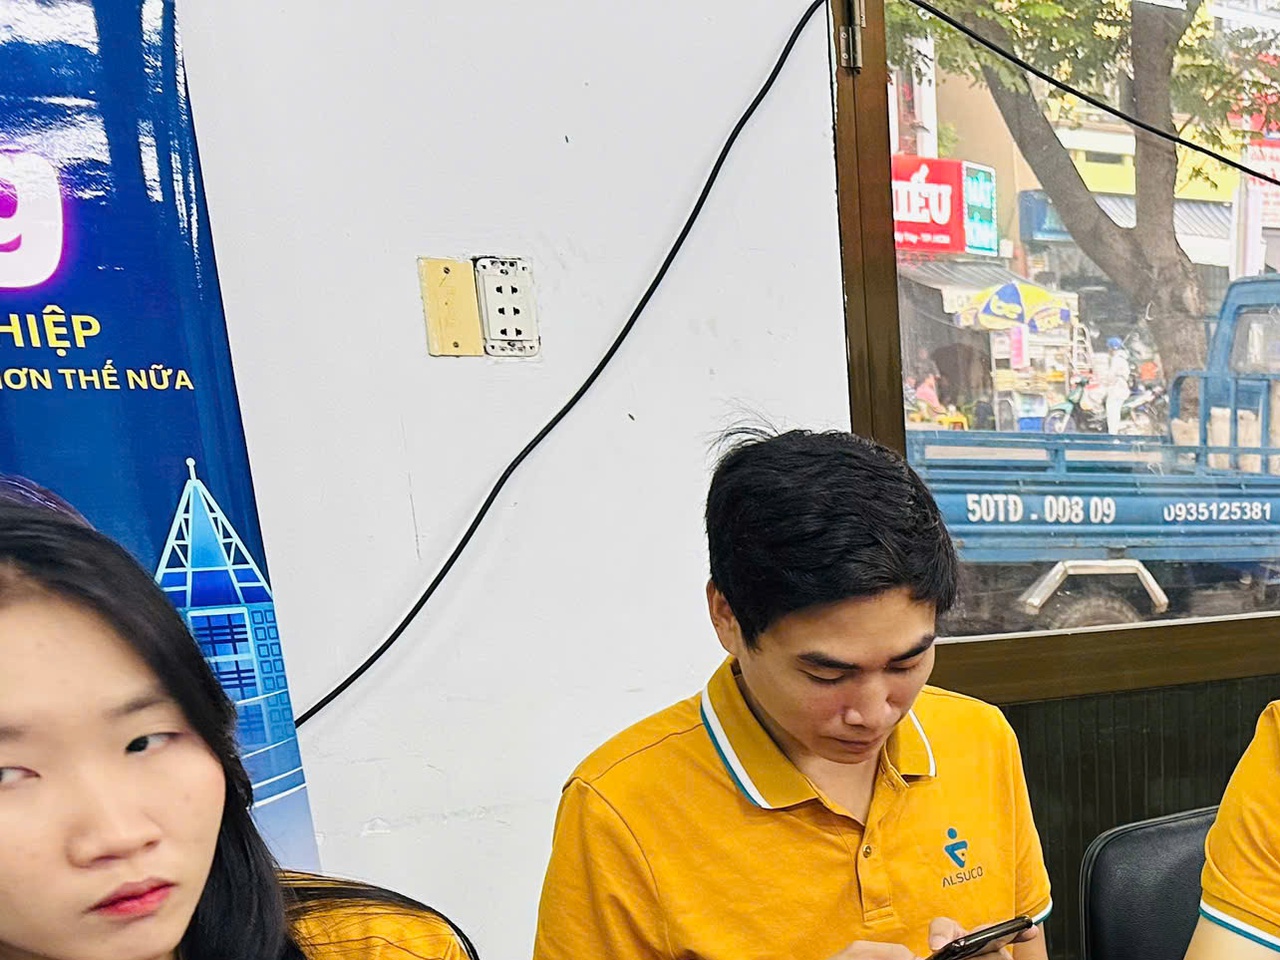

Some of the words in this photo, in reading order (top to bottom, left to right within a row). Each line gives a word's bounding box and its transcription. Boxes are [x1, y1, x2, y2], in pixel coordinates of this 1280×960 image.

[57, 359, 121, 390] THẾ
[126, 363, 195, 391] NỮA
[966, 493, 1023, 523] 50TD
[1044, 495, 1084, 523] 008
[1089, 497, 1116, 523] 09
[1159, 502, 1275, 524] 0935125381
[942, 866, 983, 888] ALSUCO
